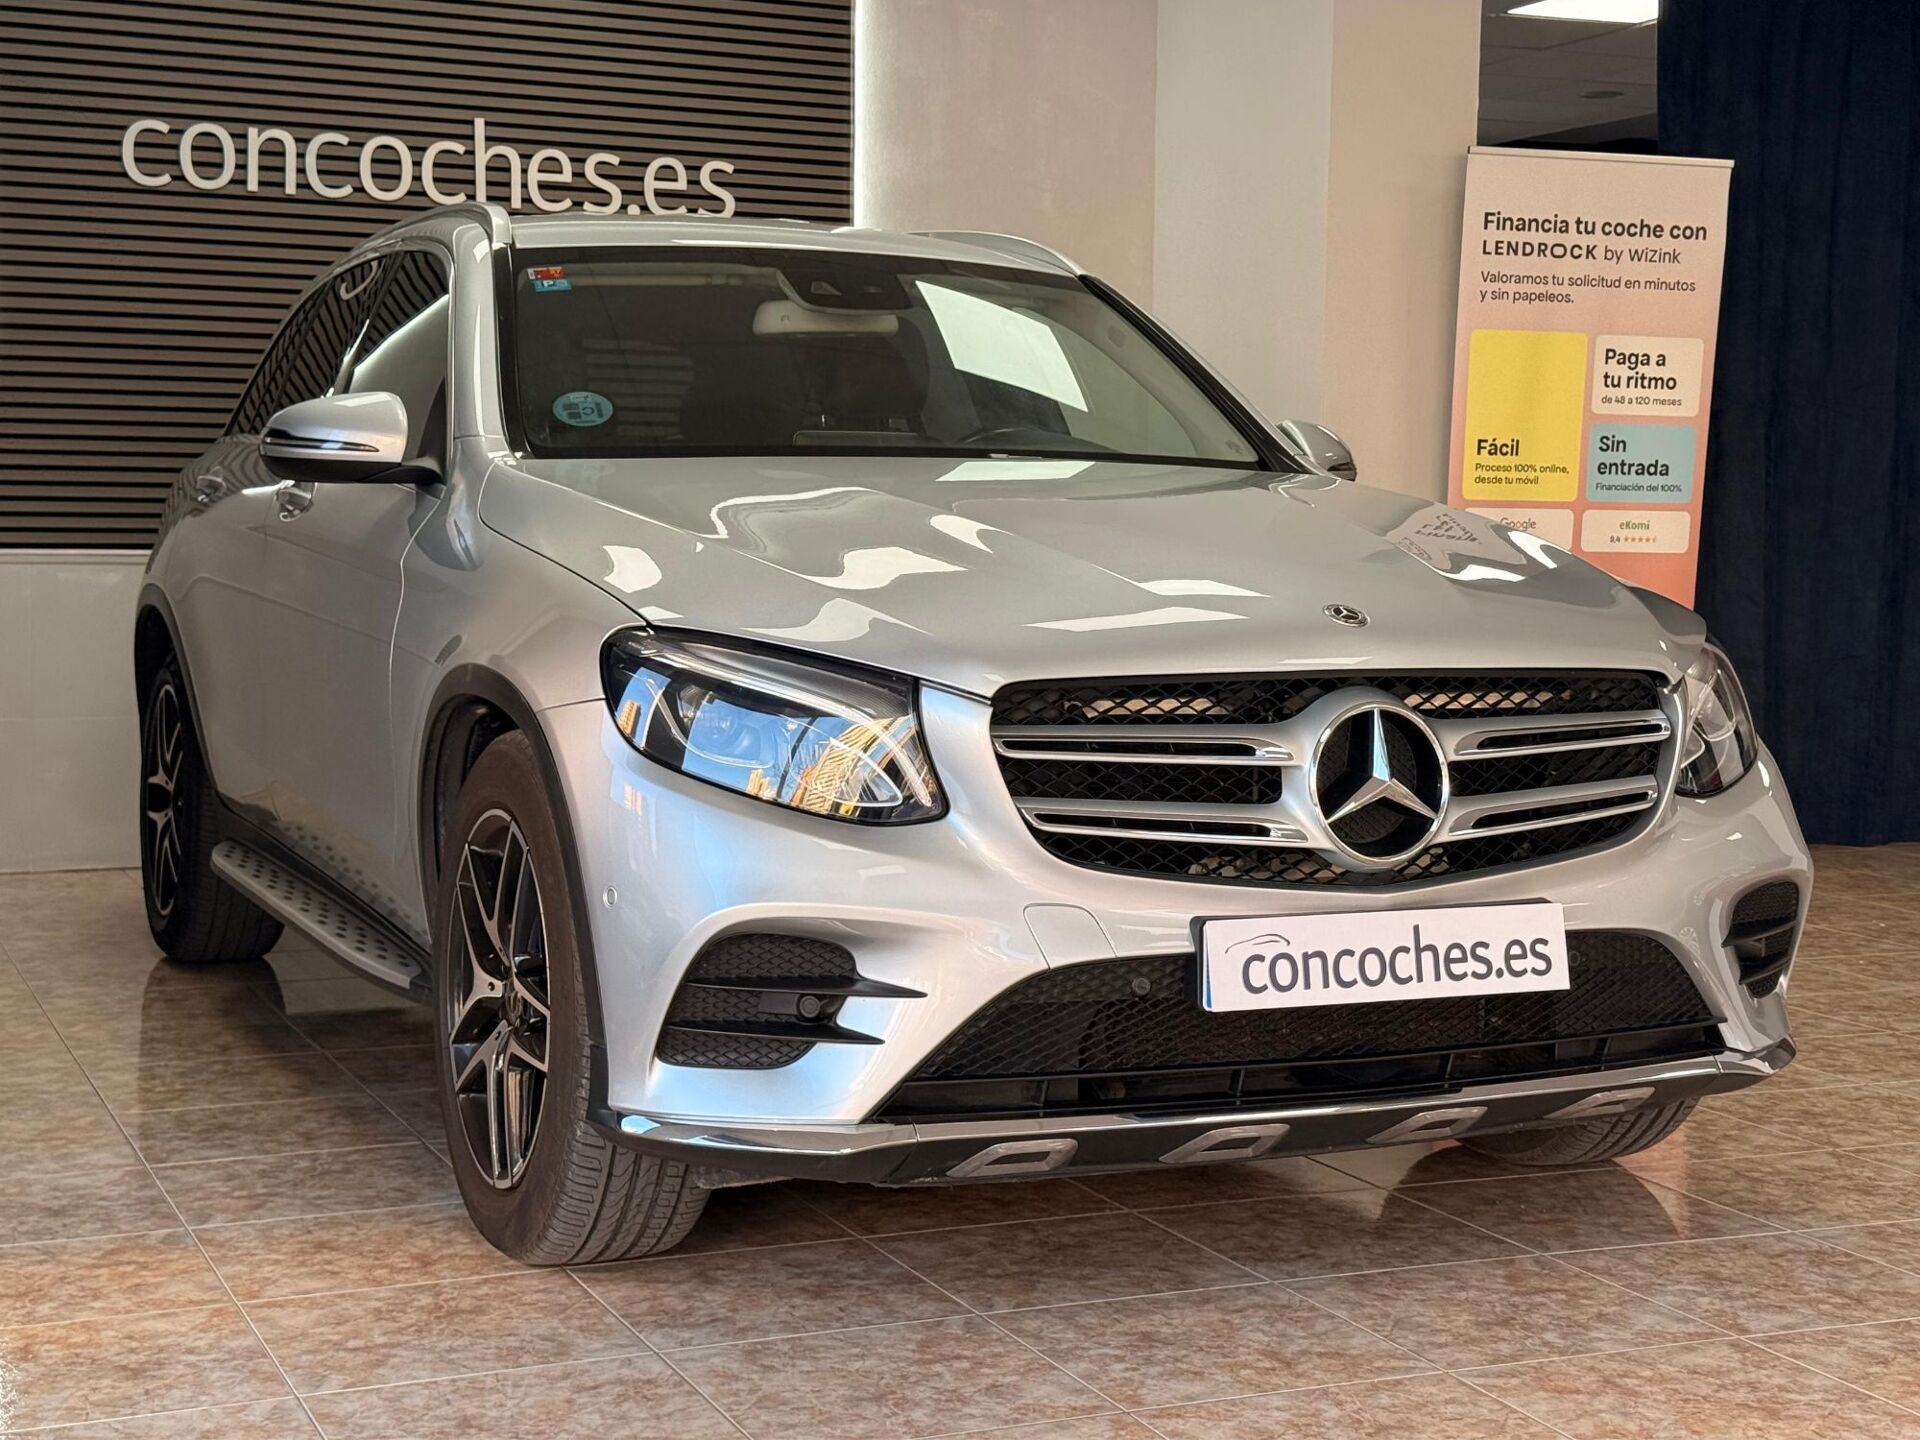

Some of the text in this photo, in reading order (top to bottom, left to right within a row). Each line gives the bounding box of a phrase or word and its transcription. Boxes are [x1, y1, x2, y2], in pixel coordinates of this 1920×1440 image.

[121, 117, 736, 218] concoches.es
[1483, 211, 1708, 240] Financia tu coche con
[1482, 240, 1597, 260] LENDROCK
[1604, 246, 1623, 266] by
[1481, 271, 1696, 292] Valoramos tu solicitud en minutos
[1480, 289, 1575, 305] y sin papeleos.
[1604, 348, 1666, 370] Paga a
[1603, 371, 1677, 390] tu ritmo
[1601, 395, 1613, 404] de
[1635, 396, 1650, 406] 120
[1652, 399, 1682, 407] meses
[1476, 438, 1520, 457] Fácil
[1598, 435, 1627, 453] Sin
[1475, 463, 1569, 475] Proceso 100% online,
[1597, 458, 1670, 477] entrada
[1474, 474, 1539, 485] desde tu móvil
[1595, 482, 1682, 494] Financiación del 100%
[1619, 521, 1650, 531] eKomi
[1242, 924, 1553, 995] concoches.es
